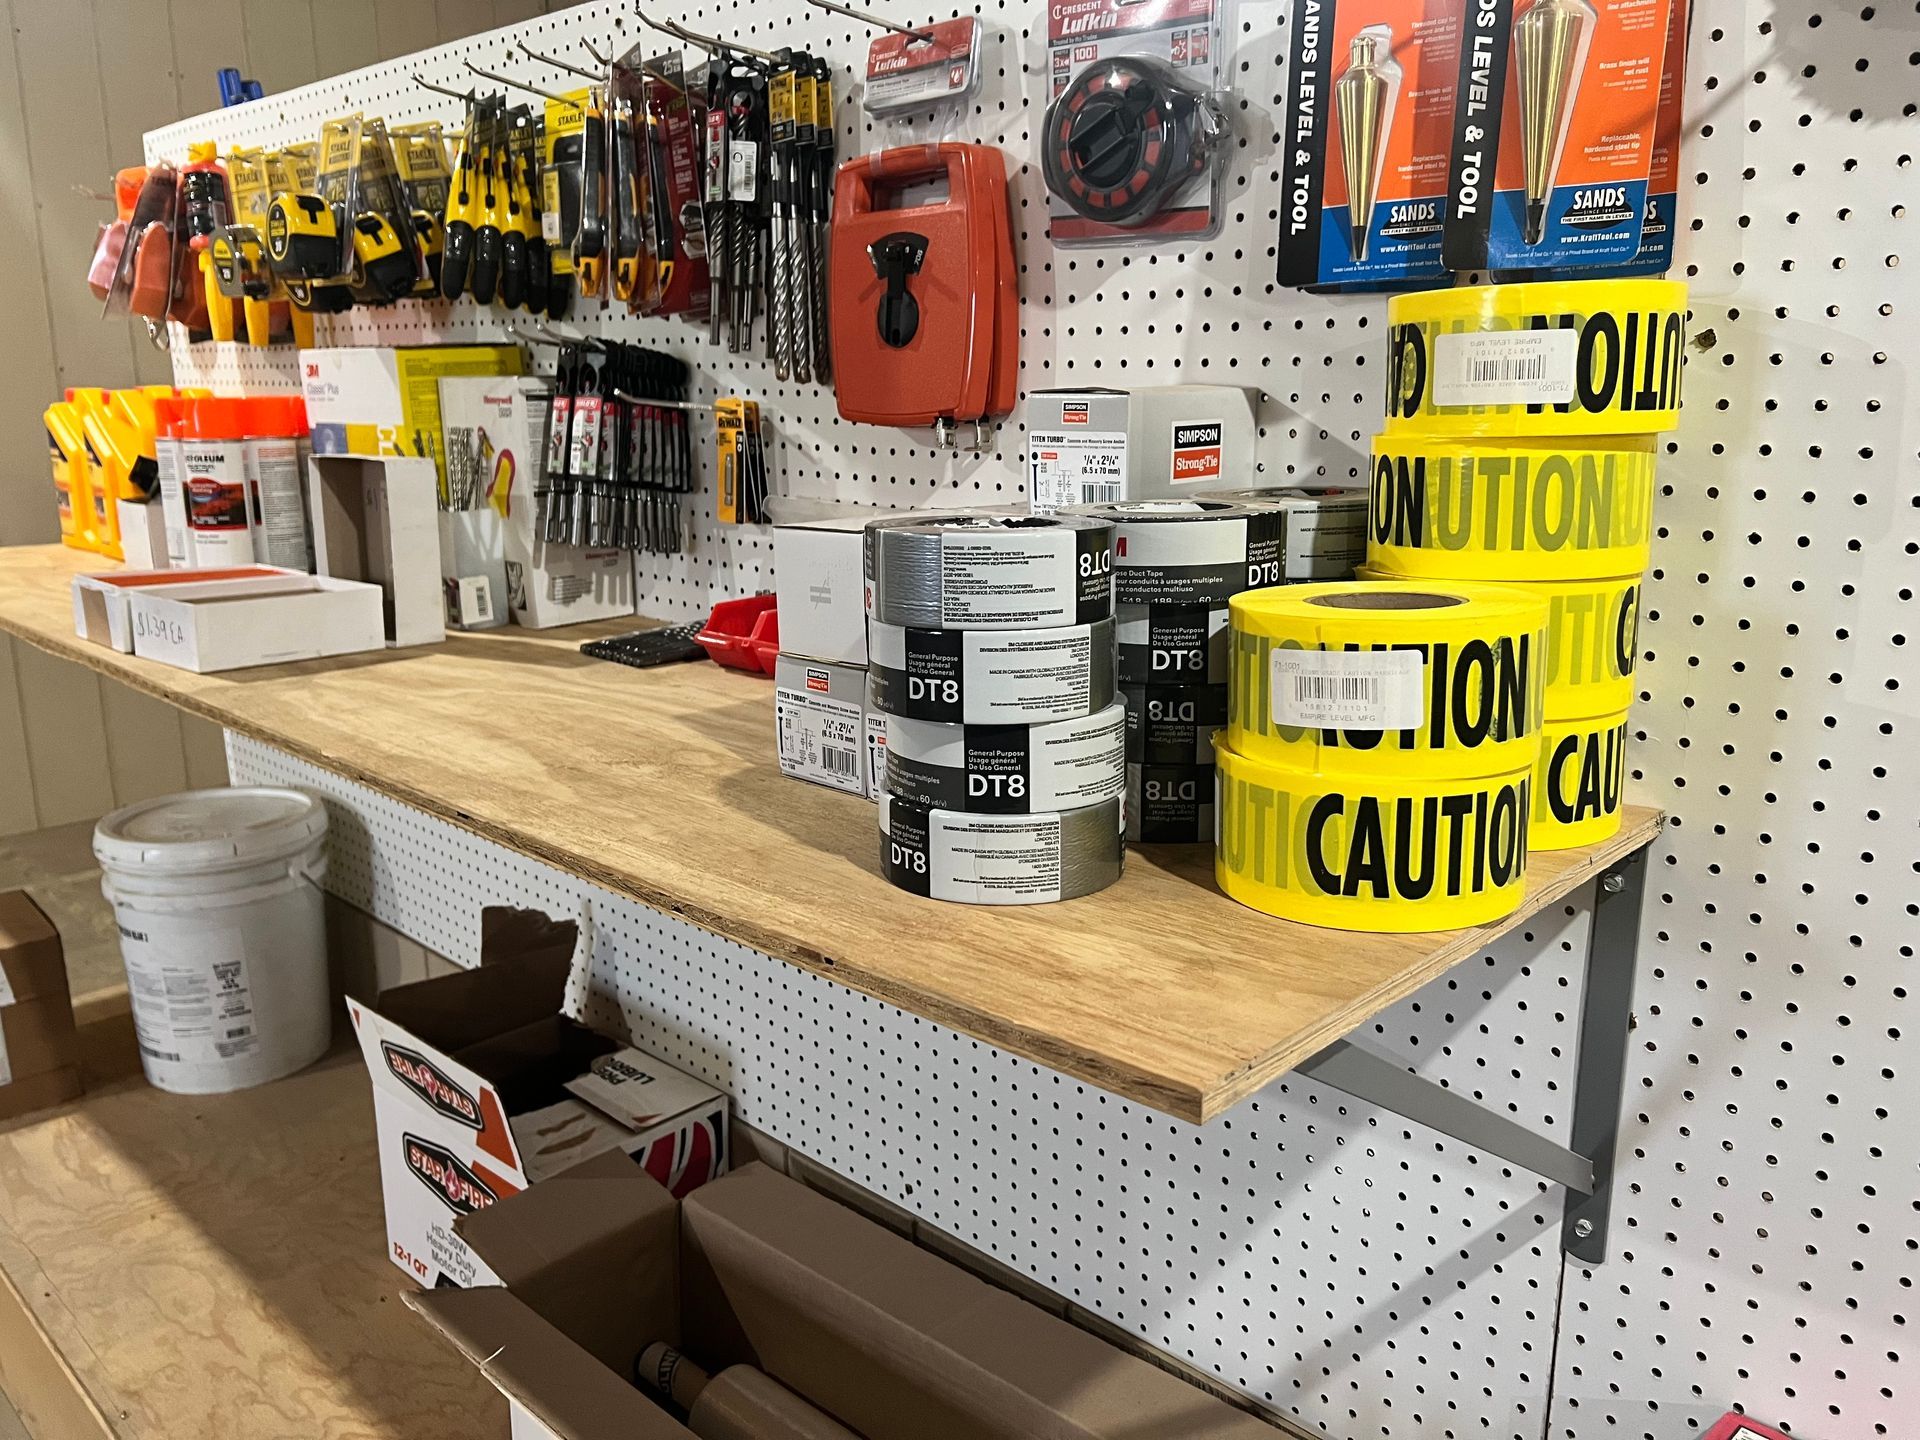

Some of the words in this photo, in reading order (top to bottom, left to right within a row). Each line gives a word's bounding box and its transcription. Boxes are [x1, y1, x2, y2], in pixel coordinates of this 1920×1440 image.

[1062, 1, 1100, 15] CRESCENT
[1061, 11, 1117, 35] Lufkin
[1302, 0, 1320, 64] ANDS
[875, 56, 907, 72] Lufkin
[1467, 36, 1494, 117] LEVEL
[1297, 71, 1316, 143] LEVEL
[1465, 125, 1484, 143] &
[1601, 133, 1640, 142] Replaceable,
[1584, 145, 1613, 153] hardened
[1295, 150, 1311, 167] &
[1457, 152, 1482, 220] TOOL
[1291, 174, 1310, 236] TOOL
[1573, 187, 1626, 210] SANDS
[1391, 203, 1435, 223] SANDS
[1560, 232, 1630, 244] www.KraftTool.com
[1381, 243, 1441, 253] www.KraftTool.com
[1489, 338, 1511, 346] LEVEL
[1515, 337, 1542, 346] EMPIRE
[307, 364, 319, 377] 3M
[1538, 384, 1570, 392] 71-1001
[1065, 403, 1087, 411] SIMPSON
[1177, 428, 1218, 444] SIMPSON
[1176, 455, 1219, 471] Strong-Tie
[1082, 467, 1093, 475] (6.5
[1108, 468, 1120, 476] mm)
[1079, 549, 1110, 577] DT8
[1128, 577, 1159, 585] conduits
[1166, 578, 1190, 586] usages
[1192, 576, 1223, 584] multiples
[1147, 570, 1163, 578] Tape
[1248, 561, 1279, 586] DT8
[908, 659, 925, 667] Usage
[932, 654, 958, 662] Purpose
[1152, 649, 1203, 670] DT8
[1274, 660, 1300, 669] 71-1001
[809, 670, 827, 678] SIMPSON
[929, 668, 954, 676] General
[778, 691, 790, 699] TITEN
[909, 677, 959, 703] DT8
[1148, 700, 1195, 722] DT8
[1300, 713, 1326, 721] EMPIRE
[968, 749, 995, 757] General
[996, 750, 1025, 758] Purpose
[991, 757, 1017, 765] général
[915, 774, 940, 784] multiples
[968, 774, 1025, 798] DT8
[1145, 781, 1196, 801] DT8
[919, 795, 930, 804] 60
[892, 842, 926, 873] DT8
[390, 1053, 422, 1084] FIRE
[438, 1081, 475, 1117] STAR
[409, 1144, 446, 1180] STAR
[431, 1222, 467, 1256] HD-30W
[393, 1242, 411, 1267] 12-1
[413, 1257, 428, 1278] QT
[426, 1231, 453, 1260] Heavy
[455, 1251, 477, 1278] Duty
[431, 1250, 457, 1275] Motor
[459, 1268, 472, 1286] Oil
